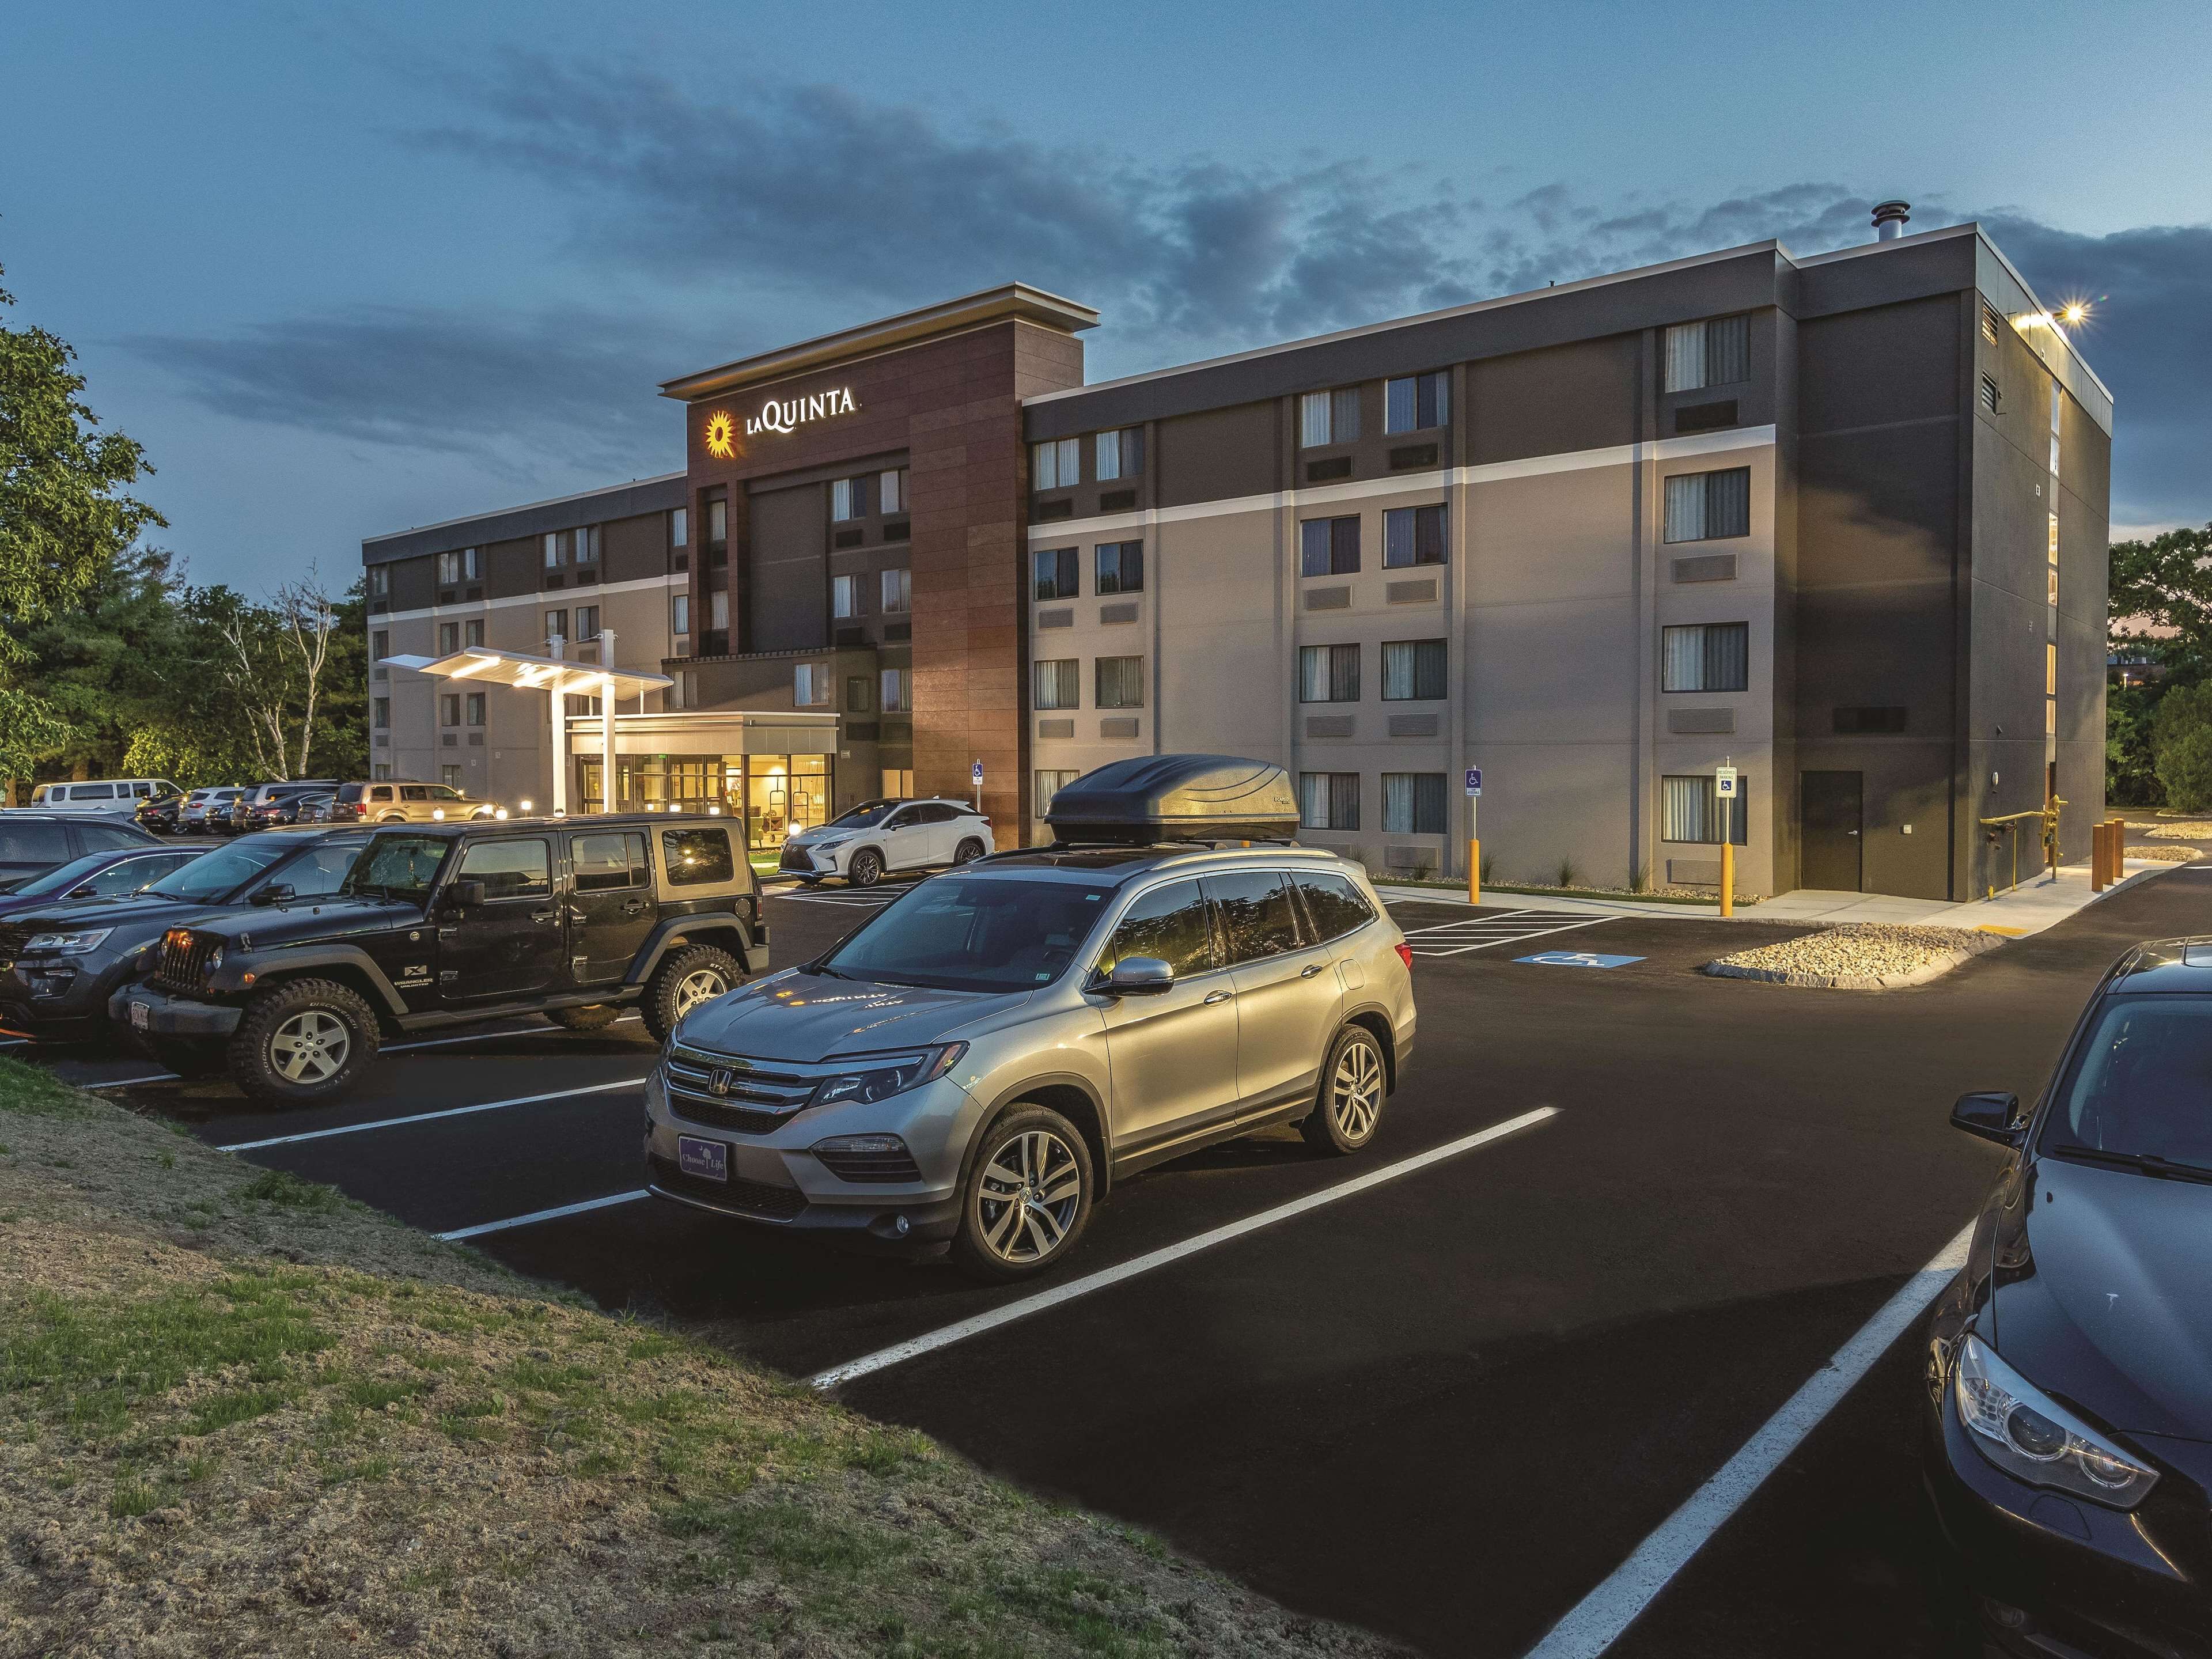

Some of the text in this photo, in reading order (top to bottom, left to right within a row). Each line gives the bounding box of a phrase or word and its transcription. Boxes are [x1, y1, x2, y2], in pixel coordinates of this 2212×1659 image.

[747, 387, 855, 434] LA QUINTA
[262, 1033, 271, 1074] COOPER
[683, 1154, 724, 1171] Choose Life
